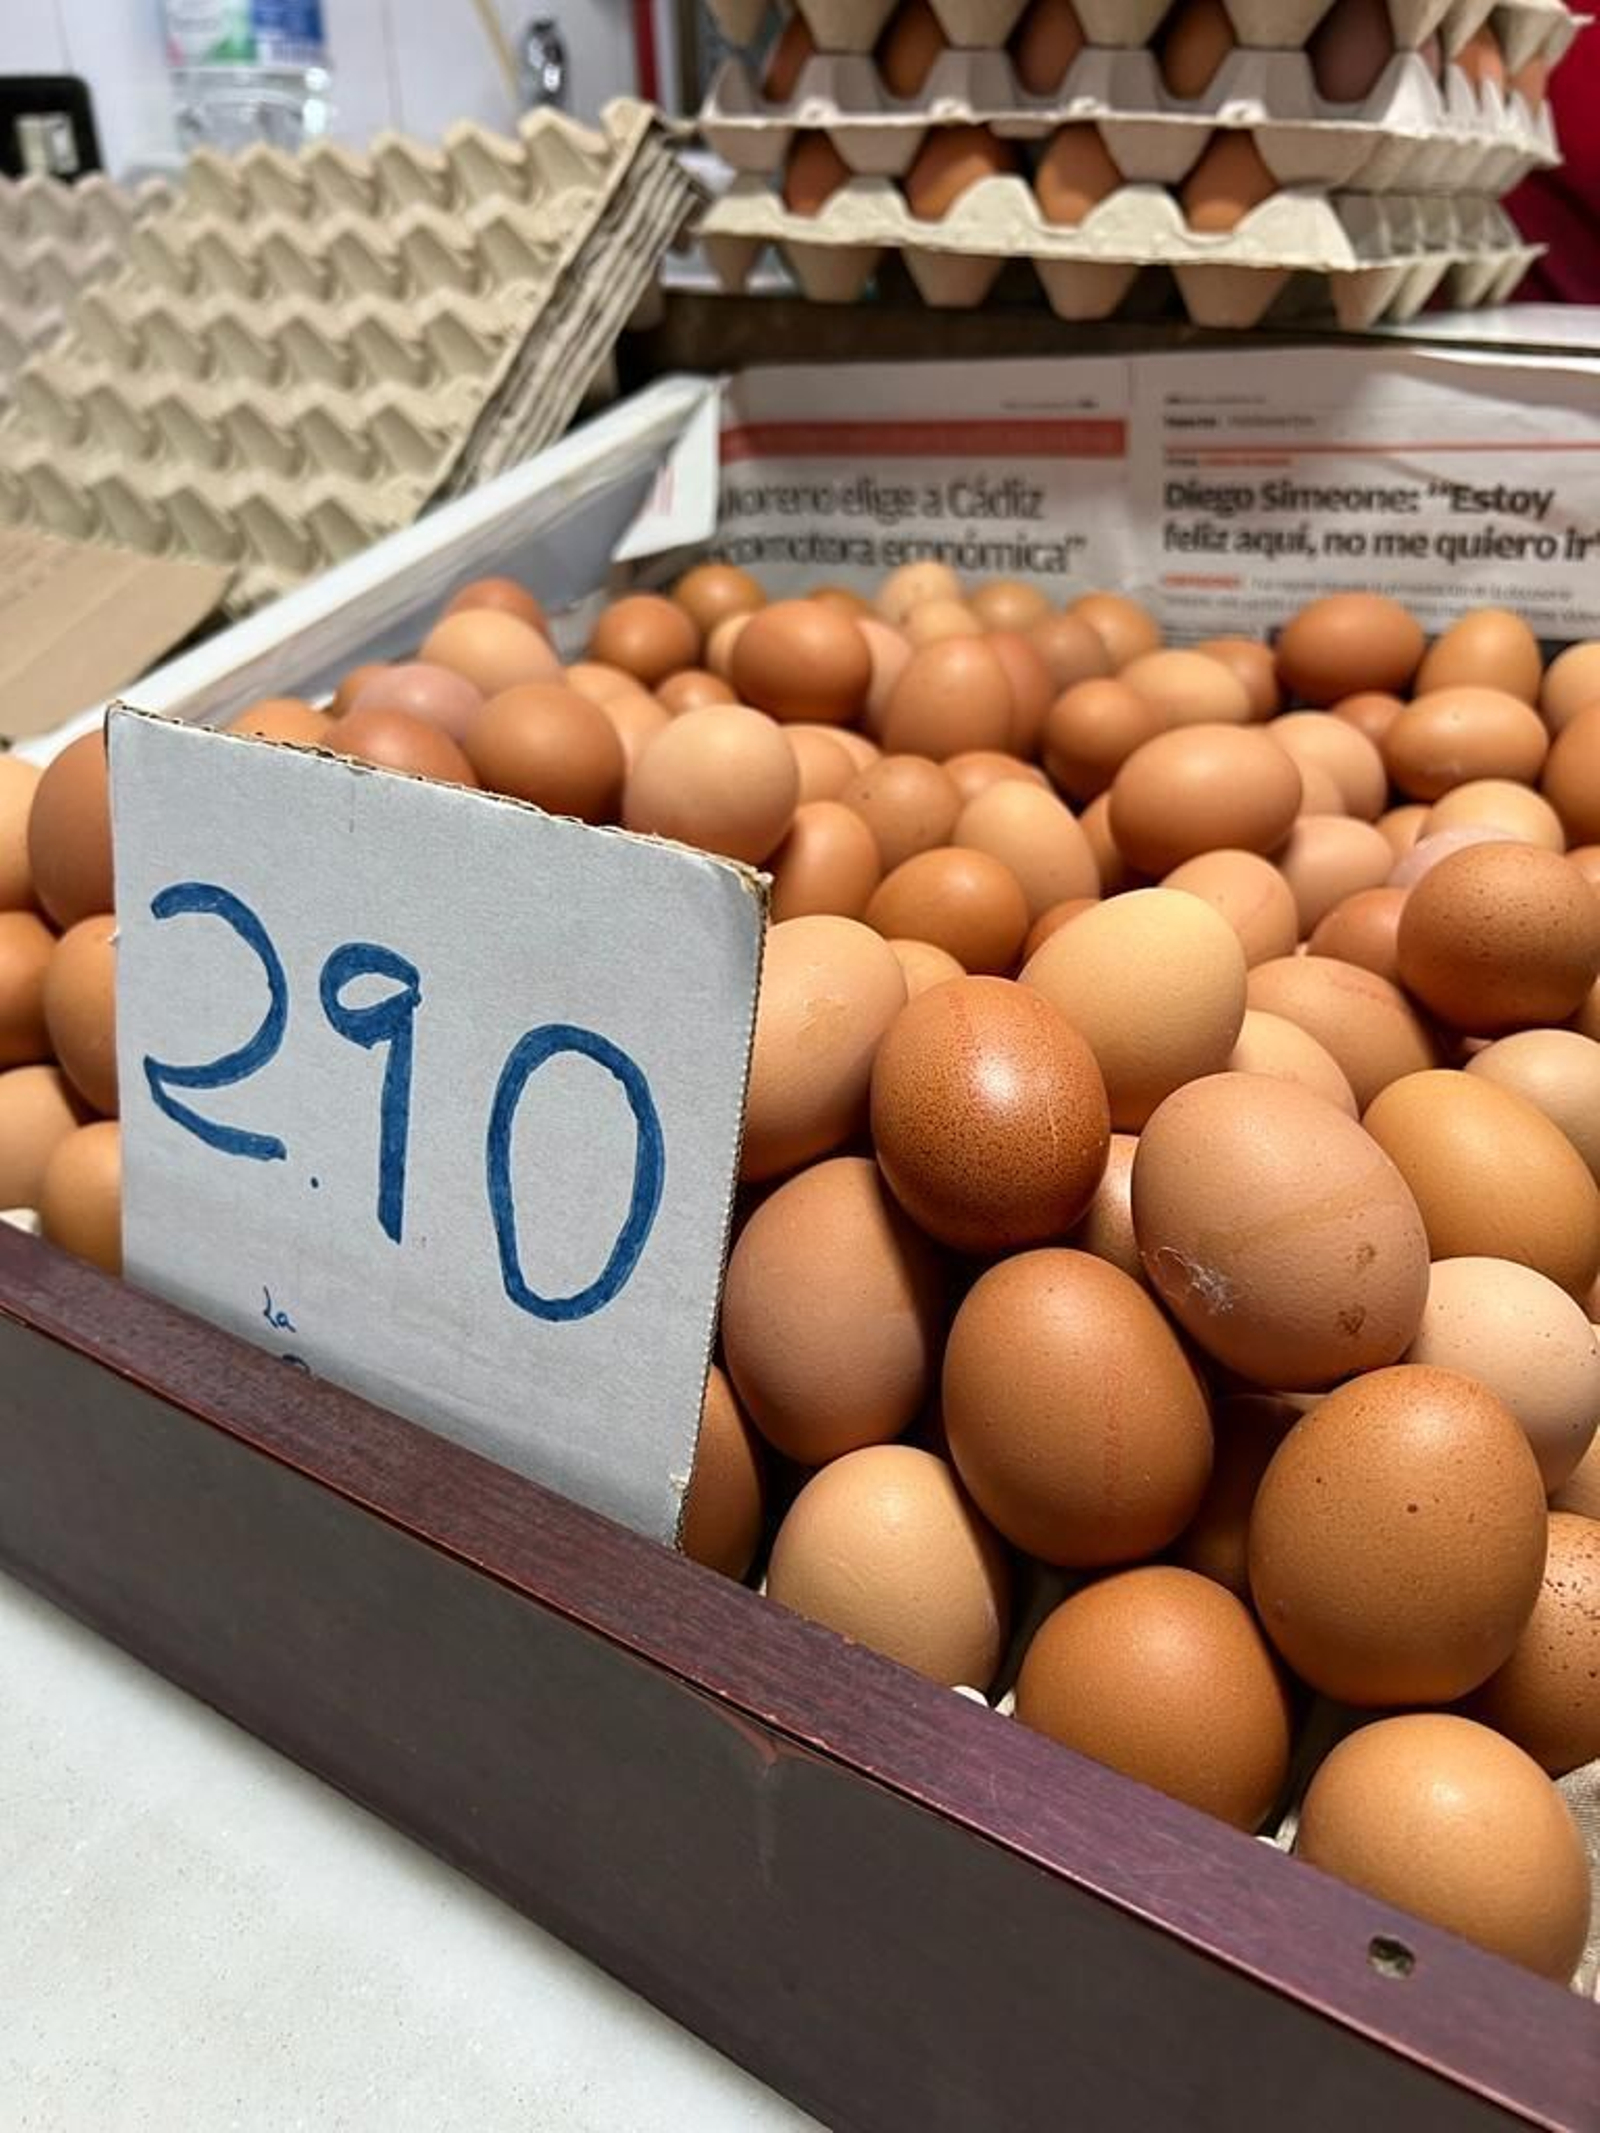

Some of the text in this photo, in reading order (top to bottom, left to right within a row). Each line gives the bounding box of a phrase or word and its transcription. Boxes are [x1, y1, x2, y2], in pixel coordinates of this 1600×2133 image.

[841, 475, 916, 526] elige
[922, 487, 941, 519] a
[947, 472, 1047, 520] Cádiz
[1164, 480, 1254, 518] Diego
[1261, 479, 1420, 514] Simeone:
[1163, 520, 1229, 554] feliz
[1233, 521, 1317, 562] aquí,
[1323, 531, 1368, 557] no
[1373, 532, 1430, 559] me
[1435, 524, 1558, 565] quiero
